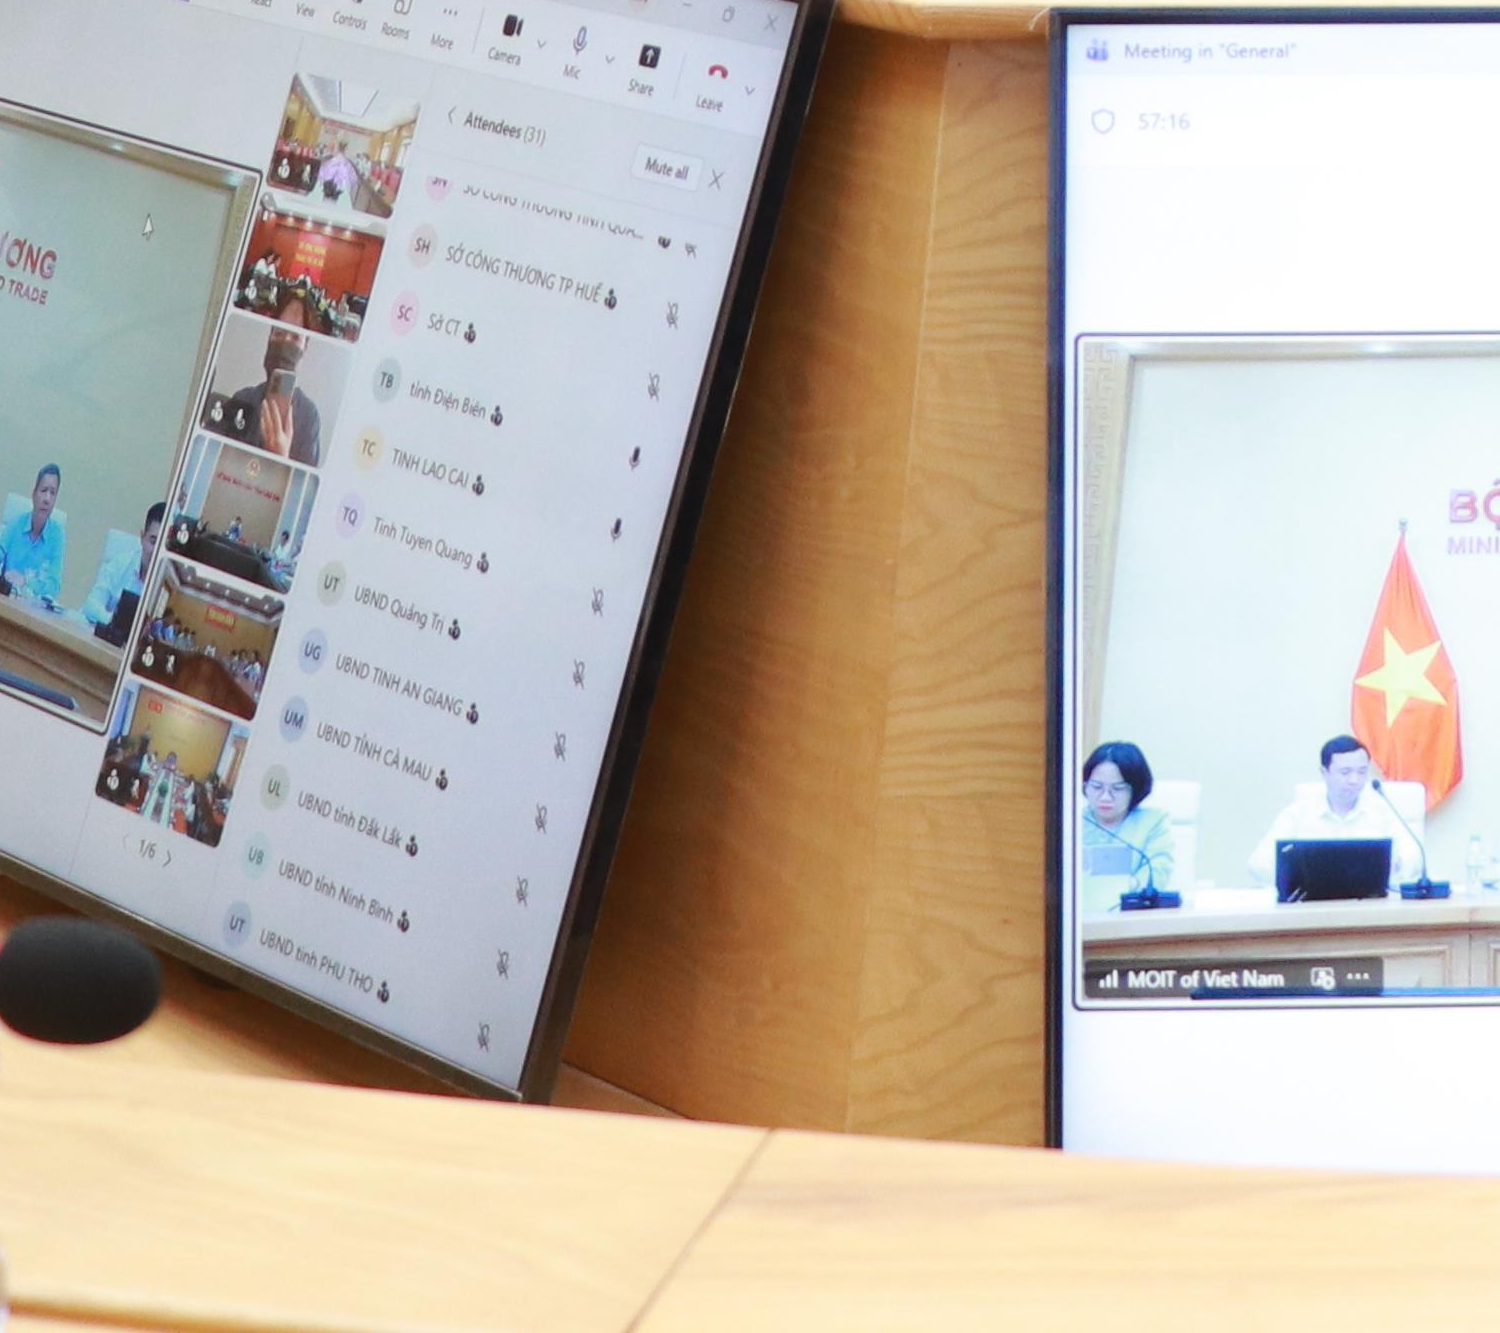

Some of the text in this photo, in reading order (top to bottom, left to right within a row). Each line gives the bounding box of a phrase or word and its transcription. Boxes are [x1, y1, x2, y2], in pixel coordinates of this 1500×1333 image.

[1124, 43, 1296, 63] Meeting in "General"
[464, 111, 547, 147] Attendees (31)
[1139, 112, 1190, 130] 57:16
[645, 157, 689, 180] Mute all
[463, 247, 502, 276] CÔNG
[501, 258, 556, 291] THƯƠNG
[557, 276, 574, 295] TP
[7, 278, 48, 305] TRADE
[432, 388, 461, 413] Điện
[461, 397, 488, 420] Biên
[353, 583, 389, 613] UBND
[388, 596, 429, 630] Quảng
[316, 721, 351, 751] UBND
[382, 744, 403, 771] CÀ
[401, 756, 432, 782] MAU
[1128, 969, 1286, 989] MOIT of Viet Nam
